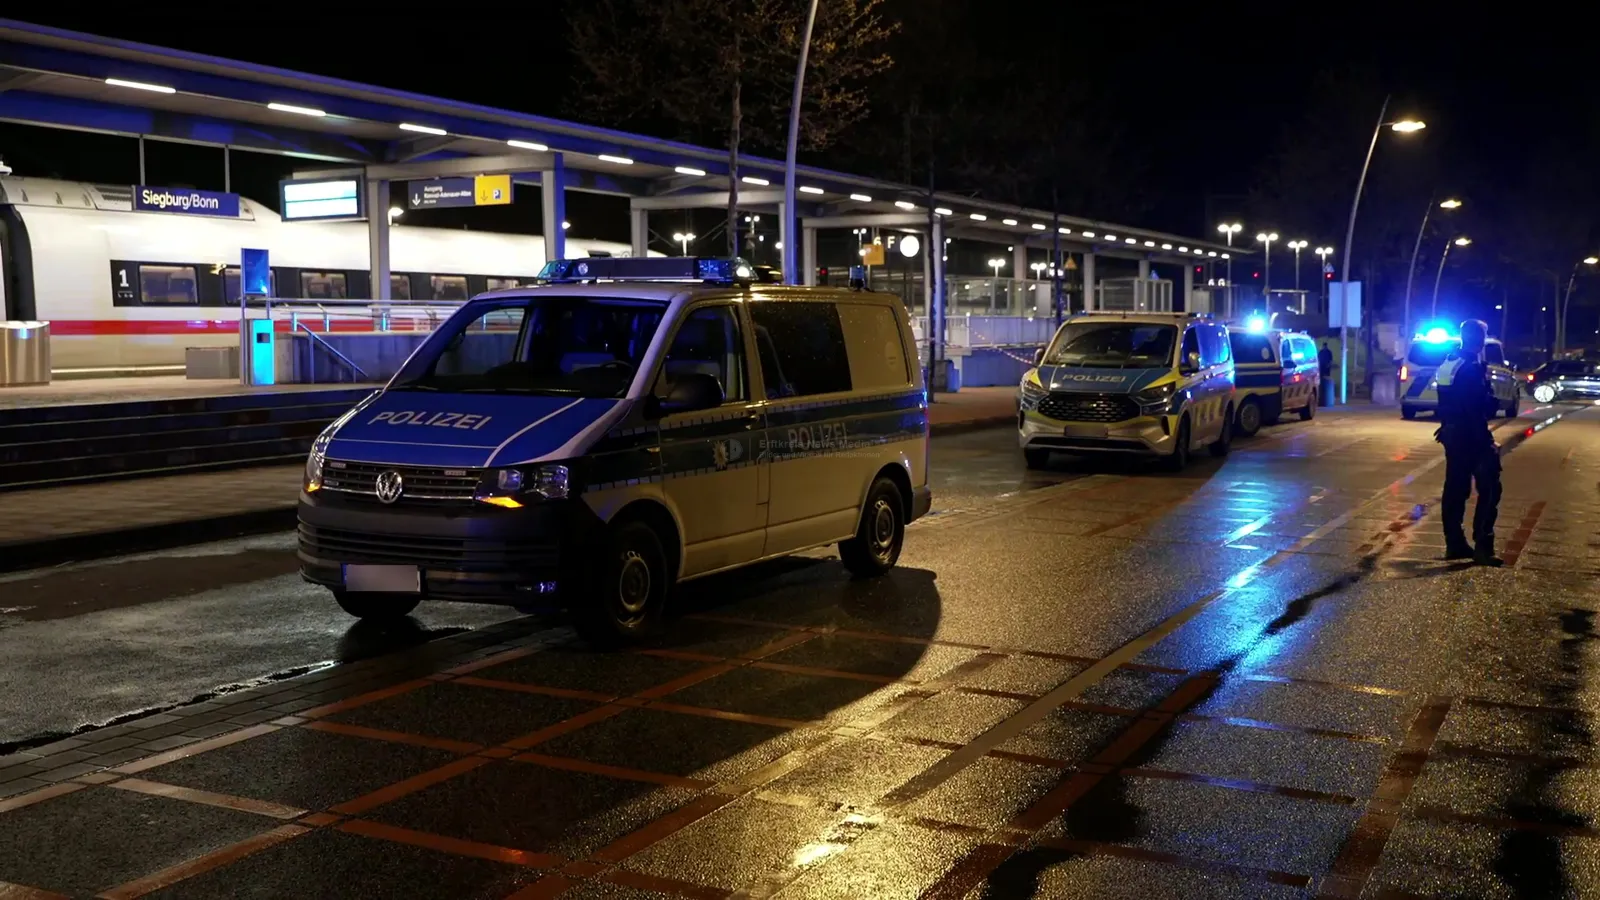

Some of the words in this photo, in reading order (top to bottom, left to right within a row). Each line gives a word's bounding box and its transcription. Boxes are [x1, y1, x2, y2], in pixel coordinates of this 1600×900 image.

[142, 189, 218, 210] Siegburg/Bonn
[887, 235, 896, 248] F
[119, 268, 129, 288] 1
[1062, 374, 1127, 383] POLIZEI
[367, 411, 492, 430] POLIZEI
[788, 422, 847, 452] POLIZEI
